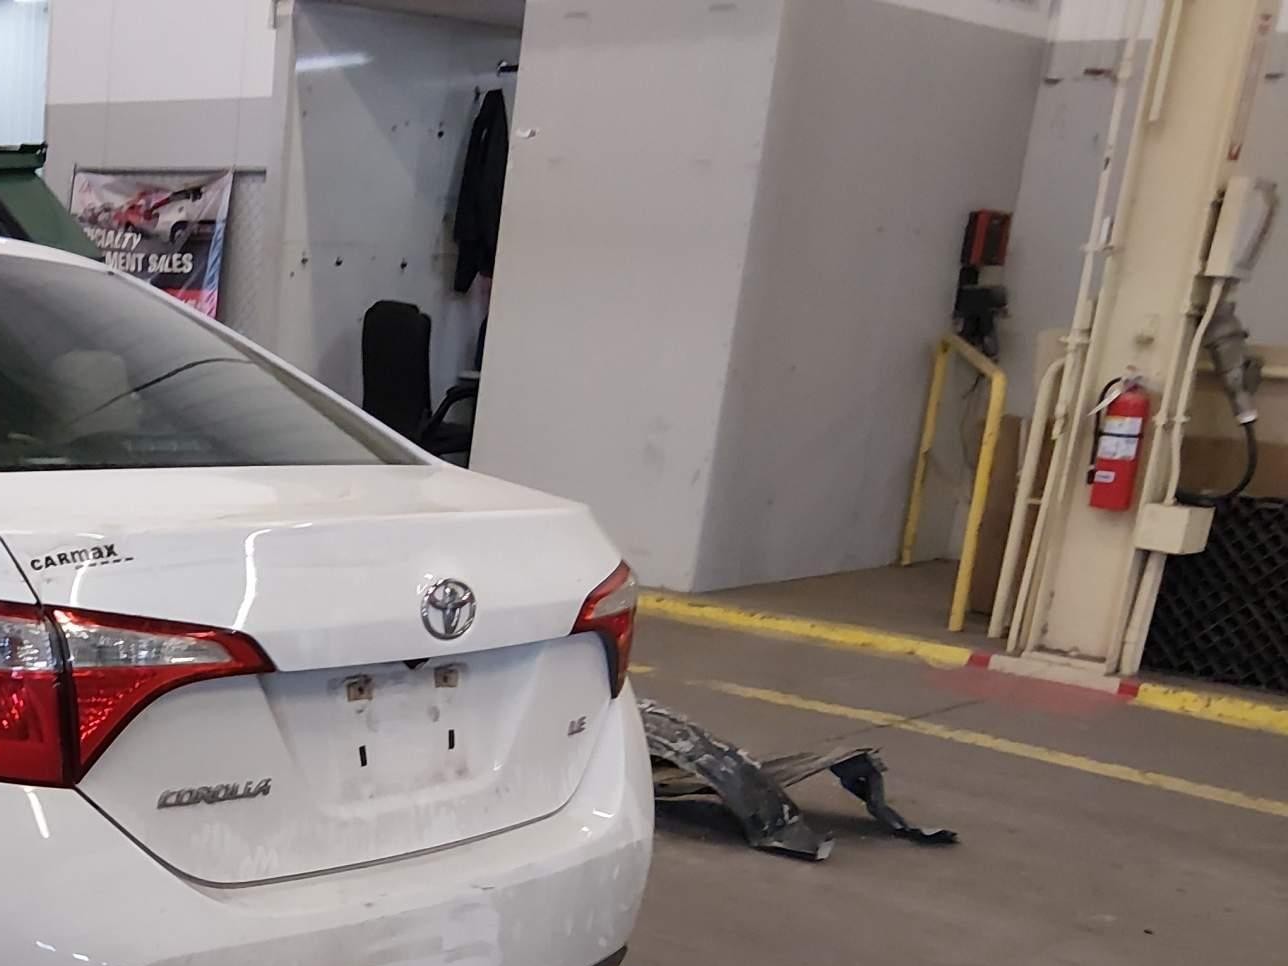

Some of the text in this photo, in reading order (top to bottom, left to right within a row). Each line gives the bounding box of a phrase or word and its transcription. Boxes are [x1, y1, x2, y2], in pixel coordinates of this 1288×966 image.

[147, 252, 194, 274] SALES
[567, 715, 587, 737] LE
[157, 778, 272, 809] COROLLA
